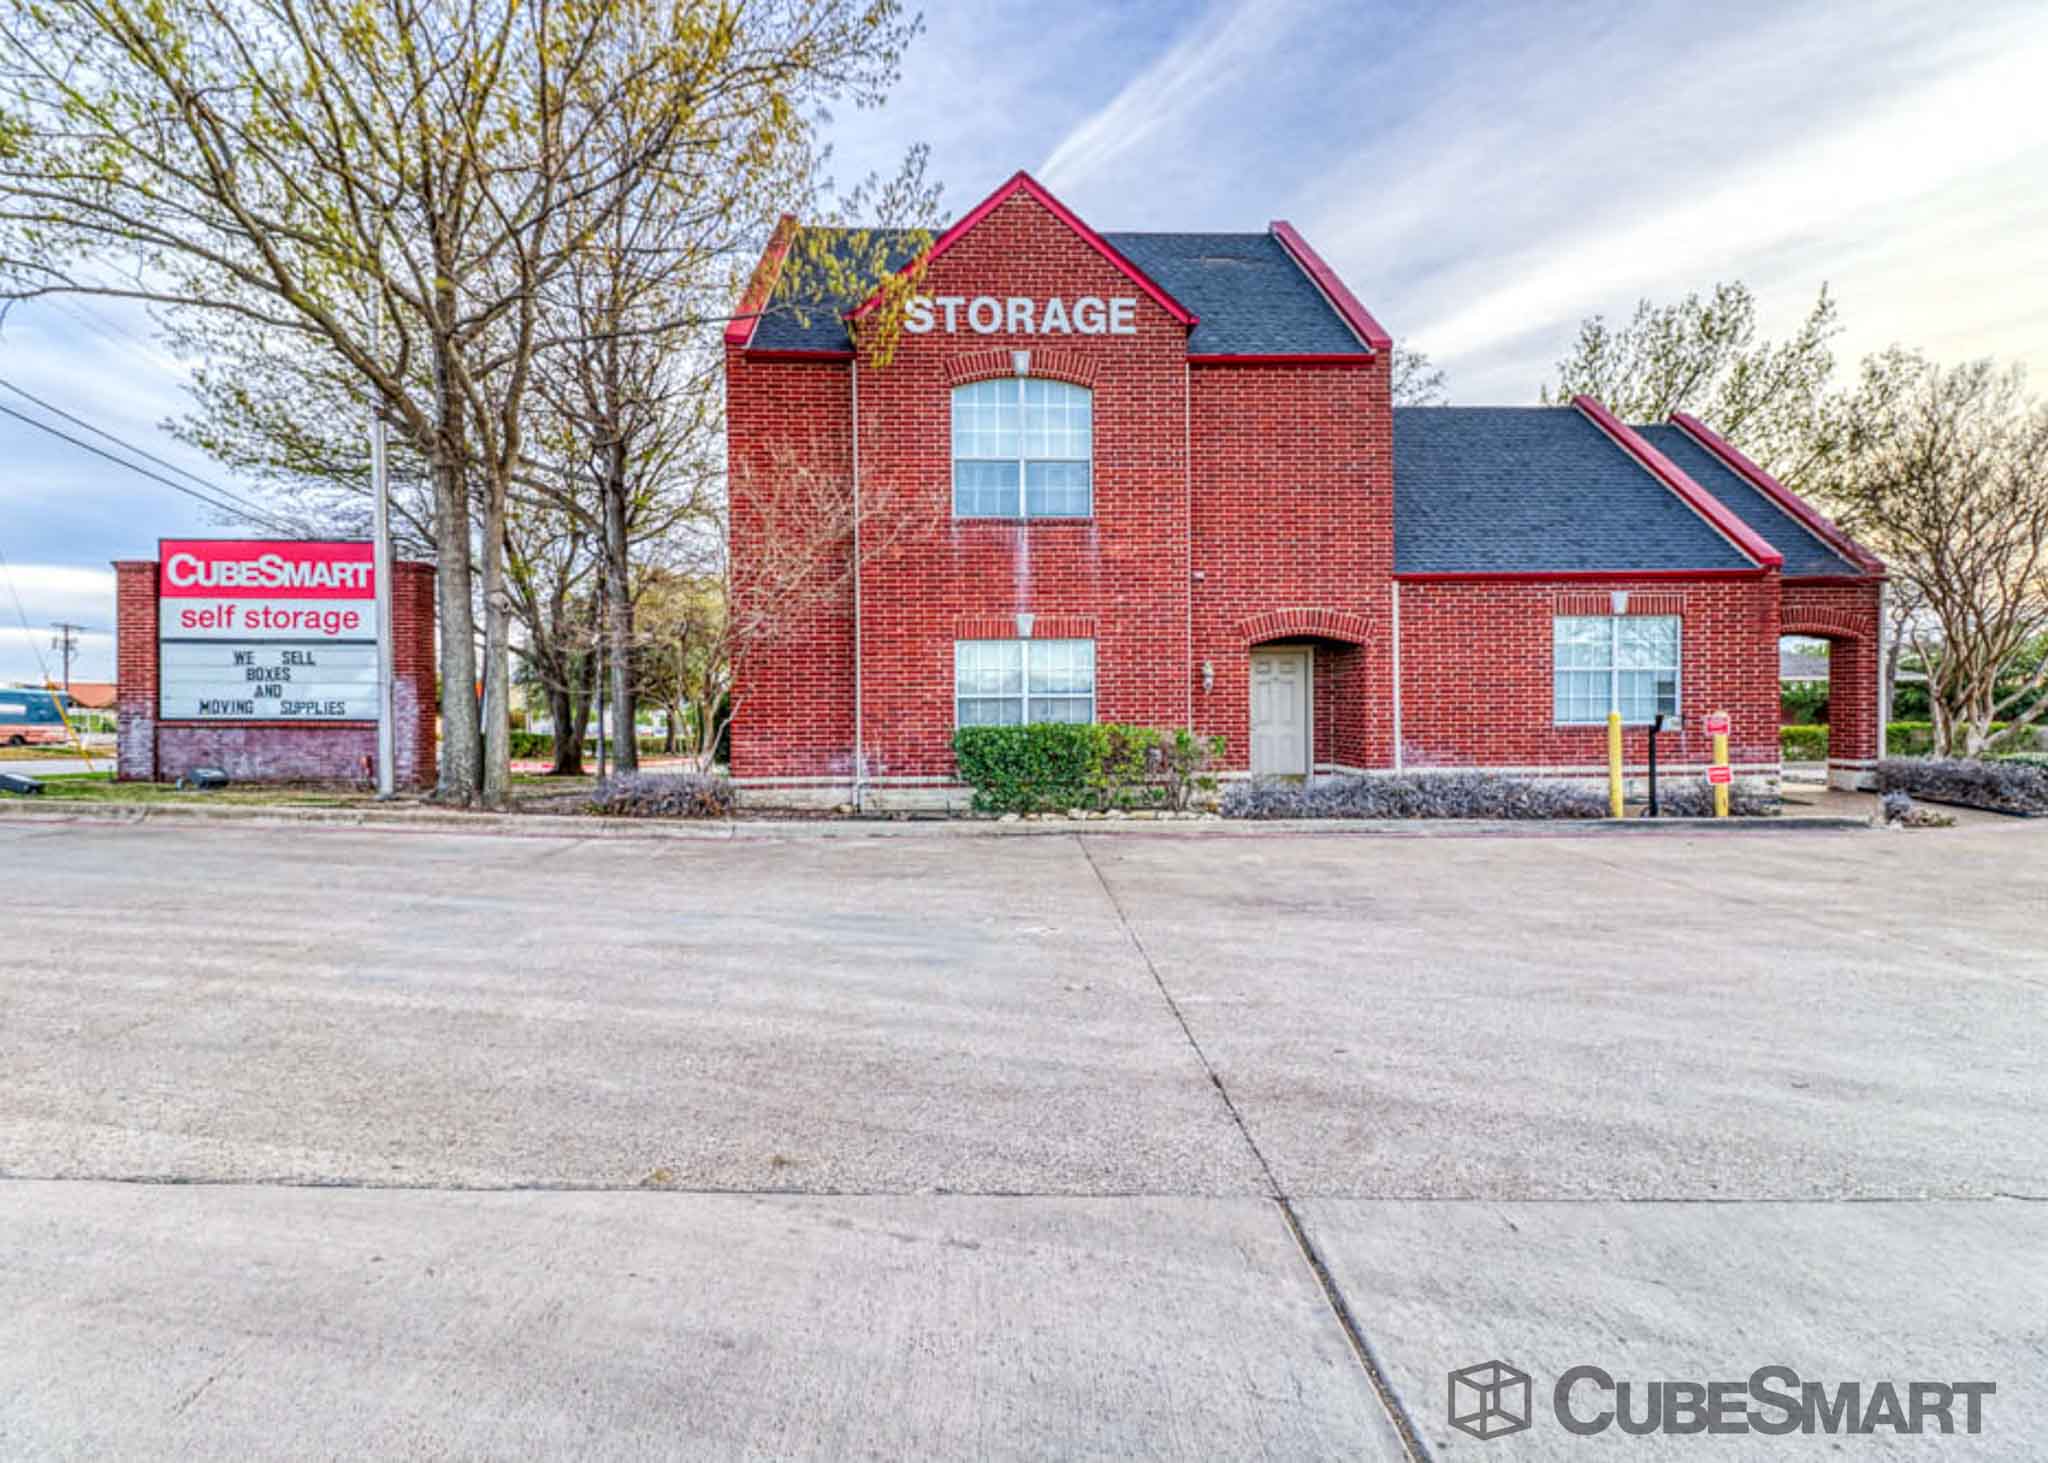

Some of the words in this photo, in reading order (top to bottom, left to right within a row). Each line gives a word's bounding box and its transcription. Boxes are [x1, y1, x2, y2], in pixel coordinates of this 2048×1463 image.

[904, 295, 1137, 334] STORAGE
[181, 605, 236, 629] self
[244, 607, 359, 634] storage
[233, 651, 255, 665] WE
[282, 651, 316, 665] SELL
[246, 667, 291, 681] BOXES
[254, 684, 282, 698] AND
[200, 701, 254, 714] MOVING
[280, 701, 345, 715] SUPPLIES
